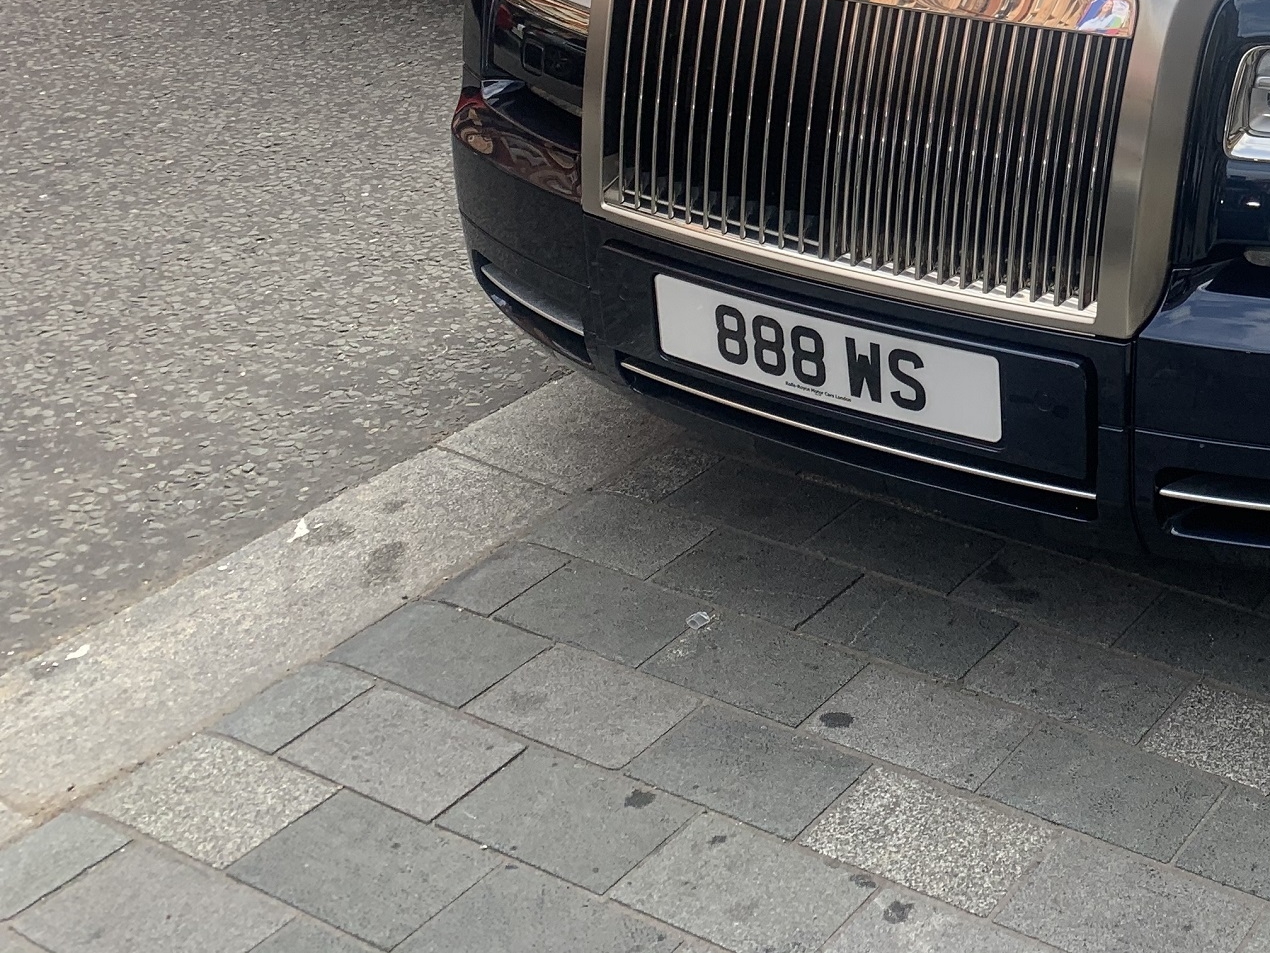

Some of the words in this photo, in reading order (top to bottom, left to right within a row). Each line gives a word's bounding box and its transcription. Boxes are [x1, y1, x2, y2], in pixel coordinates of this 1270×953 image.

[715, 304, 827, 387] 888
[845, 336, 927, 412] WS
[835, 394, 852, 402] London
